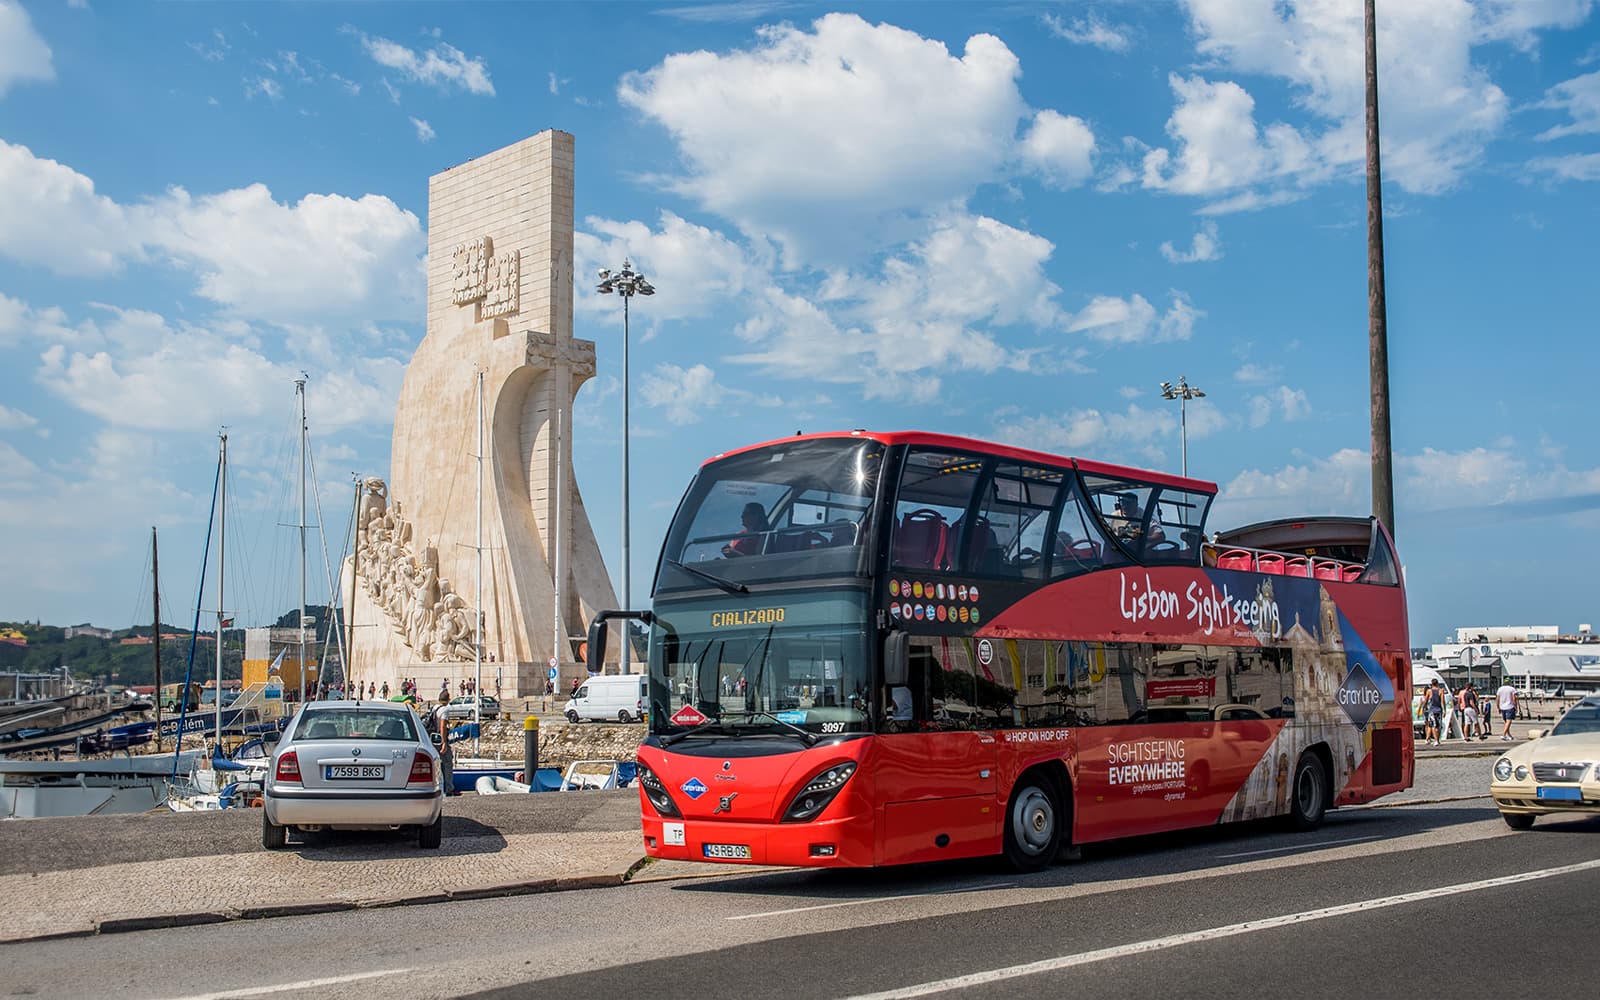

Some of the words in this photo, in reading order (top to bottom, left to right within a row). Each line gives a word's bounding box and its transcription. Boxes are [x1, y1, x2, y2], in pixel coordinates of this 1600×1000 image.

[1120, 572, 1180, 623] Lisbon
[1186, 579, 1281, 639] Sightseeing
[712, 608, 785, 627] CIALIZADO
[821, 722, 845, 733] 3097
[1012, 731, 1028, 743] HOP
[1028, 731, 1039, 742] ON
[1040, 731, 1055, 741] HOP
[1055, 730, 1069, 740] OFF
[334, 767, 359, 777] 7599
[362, 767, 381, 777] BKS
[1109, 761, 1185, 785] EVERYWHERE
[673, 829, 683, 840] TP
